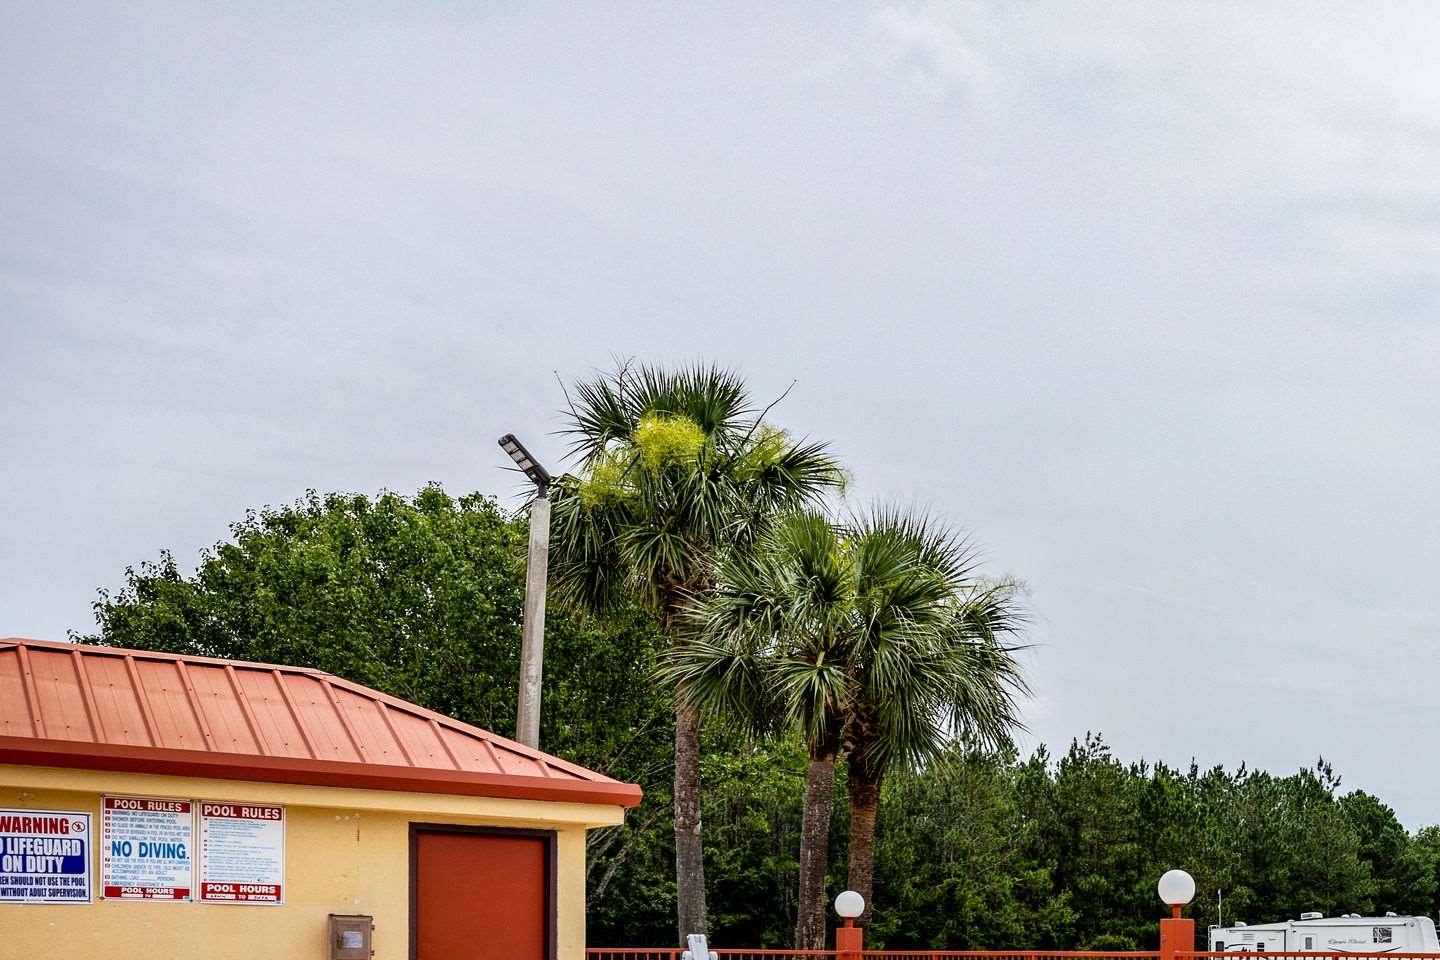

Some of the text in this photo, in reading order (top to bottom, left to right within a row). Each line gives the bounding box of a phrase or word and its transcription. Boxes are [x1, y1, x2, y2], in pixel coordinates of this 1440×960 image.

[114, 800, 182, 812] POOL RULES
[204, 805, 280, 819] POOL RULES
[0, 815, 70, 834] WARNING
[7, 838, 81, 856] LIFEGUARD
[112, 841, 132, 857] NO
[139, 842, 190, 859] DIVING.
[2, 855, 64, 873] ON DUTY
[10, 876, 33, 885] SHOULD
[35, 876, 46, 885] NOT
[48, 877, 58, 886] USE
[60, 877, 70, 886] THE
[71, 877, 85, 886] POOL
[1, 887, 28, 896] WITHOUT
[30, 888, 46, 897] ADULT
[207, 884, 276, 894] POOL HOURS
